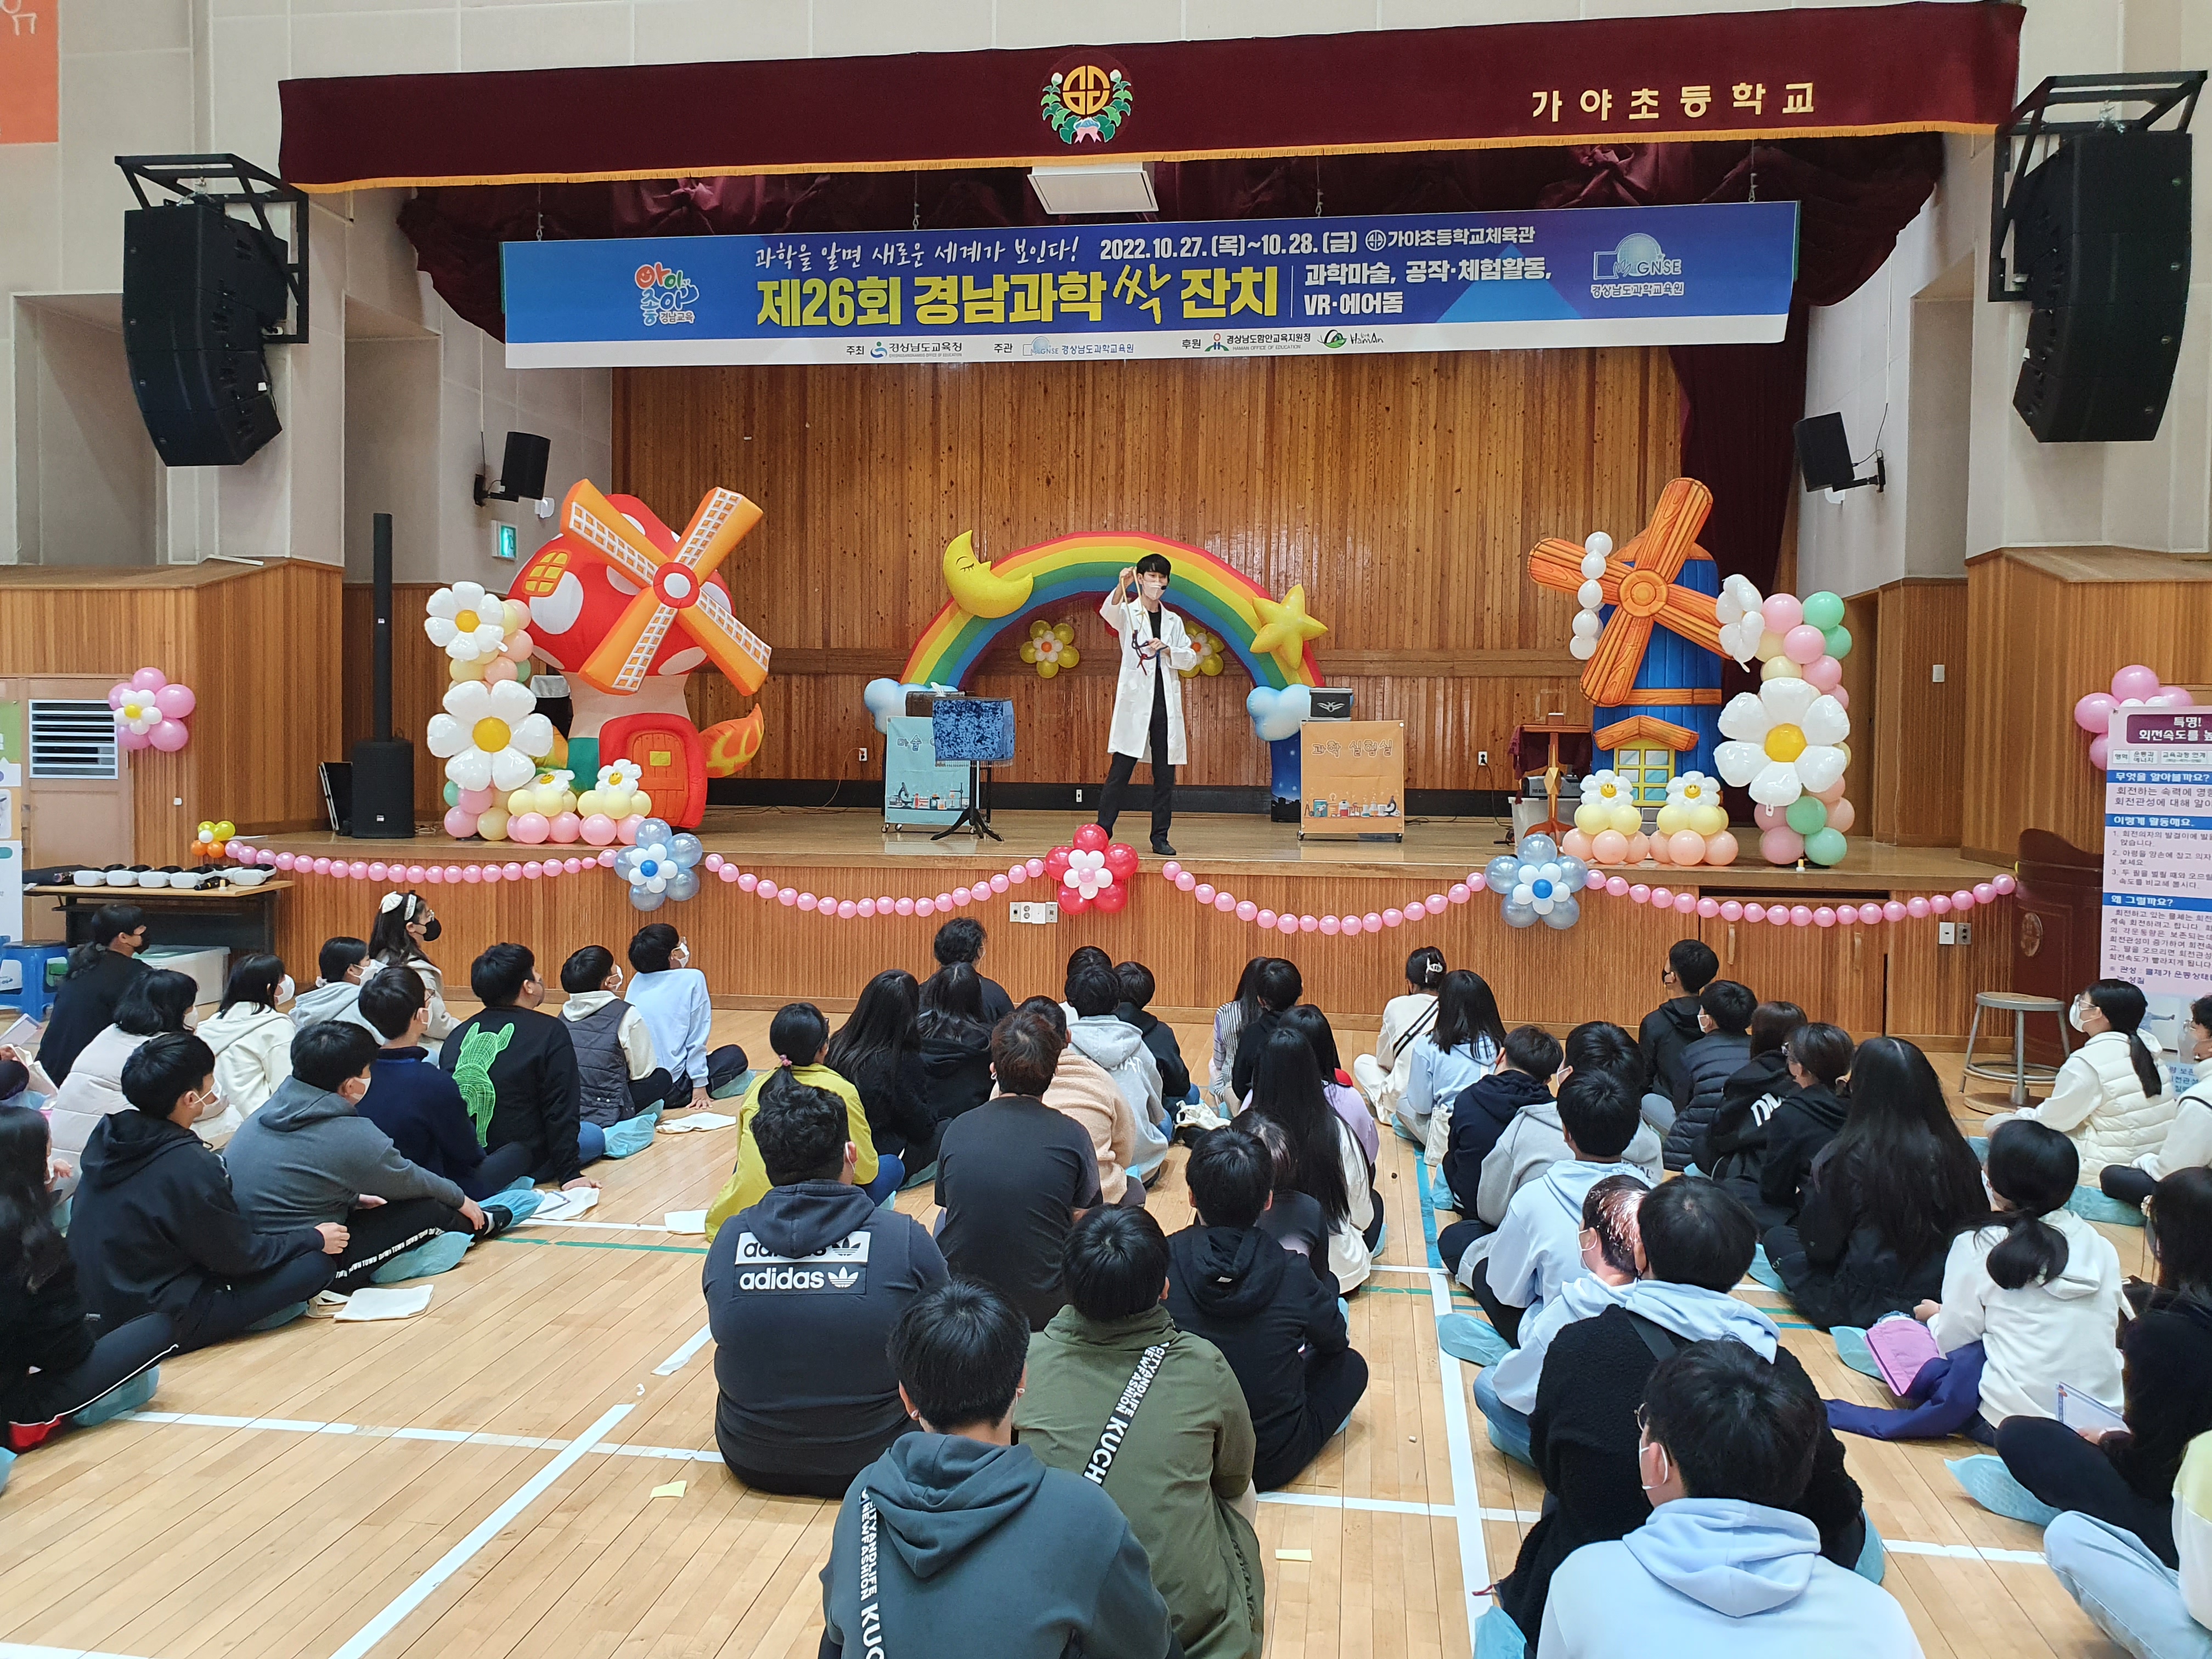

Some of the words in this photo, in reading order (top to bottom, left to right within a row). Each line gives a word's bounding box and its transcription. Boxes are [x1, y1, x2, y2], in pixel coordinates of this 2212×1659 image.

[1532, 82, 1814, 122] 가야초등학교
[1388, 226, 1536, 247] 가야초등학교체육관
[755, 242, 812, 272] 과학을
[822, 241, 861, 271] 알면
[872, 242, 924, 268] 새로운
[934, 240, 1006, 264] 세계가
[1015, 236, 1079, 263] 보인다!
[1305, 261, 1396, 286] 과학마술,
[1406, 257, 1551, 283] 공작·체험활동,
[1637, 260, 1681, 274] GNSE
[635, 262, 683, 290] 아이
[757, 276, 901, 326] 제26회
[914, 271, 1107, 324] 경남과학
[1113, 263, 1171, 324] 싹
[1181, 266, 1278, 319] 잔치
[1592, 283, 1683, 297] 경상남도과학교육원
[1304, 291, 1403, 315] VR·에어돔
[660, 311, 695, 324] 경남교육
[1182, 338, 1201, 349] 후원
[1227, 333, 1311, 344] 경상남도함안교육지원청
[847, 345, 865, 356] 주최
[889, 342, 962, 353] 경상남도교육청
[994, 343, 1013, 353] 주관
[1062, 343, 1134, 355] 경상남도과학교육원
[2174, 716, 2202, 728] 특명!
[897, 734, 922, 752] 마술
[2139, 730, 2199, 742] 회전속도를
[1312, 740, 1341, 758] 과학
[1350, 739, 1392, 757] 실험실
[2115, 772, 2146, 782] 무엇을
[2150, 772, 2210, 782] 알아볼까요?
[2117, 786, 2157, 795] 회전하는
[2161, 787, 2192, 797] 속력에
[2115, 797, 2165, 807] 회전관성에
[2170, 799, 2190, 808] 대해
[2114, 816, 2145, 826] 이렇게
[2123, 830, 2162, 838] 회전의자의
[2111, 895, 2121, 904] 왜
[2125, 896, 2174, 907] 그럴까요?
[2115, 909, 2147, 917] 회전하고
[2150, 911, 2166, 919] 있는
[2130, 919, 2170, 928] 회전하려고
[2109, 936, 2149, 944] 회전관성이
[2109, 953, 2148, 963] 회전속도가
[2143, 947, 2175, 956] 오므리면
[2120, 966, 2137, 974] 관성
[2174, 970, 2212, 981] 운동상태
[362, 1256, 377, 1267] TOWN
[392, 1242, 405, 1253] TOWN
[740, 1267, 825, 1290] adidas
